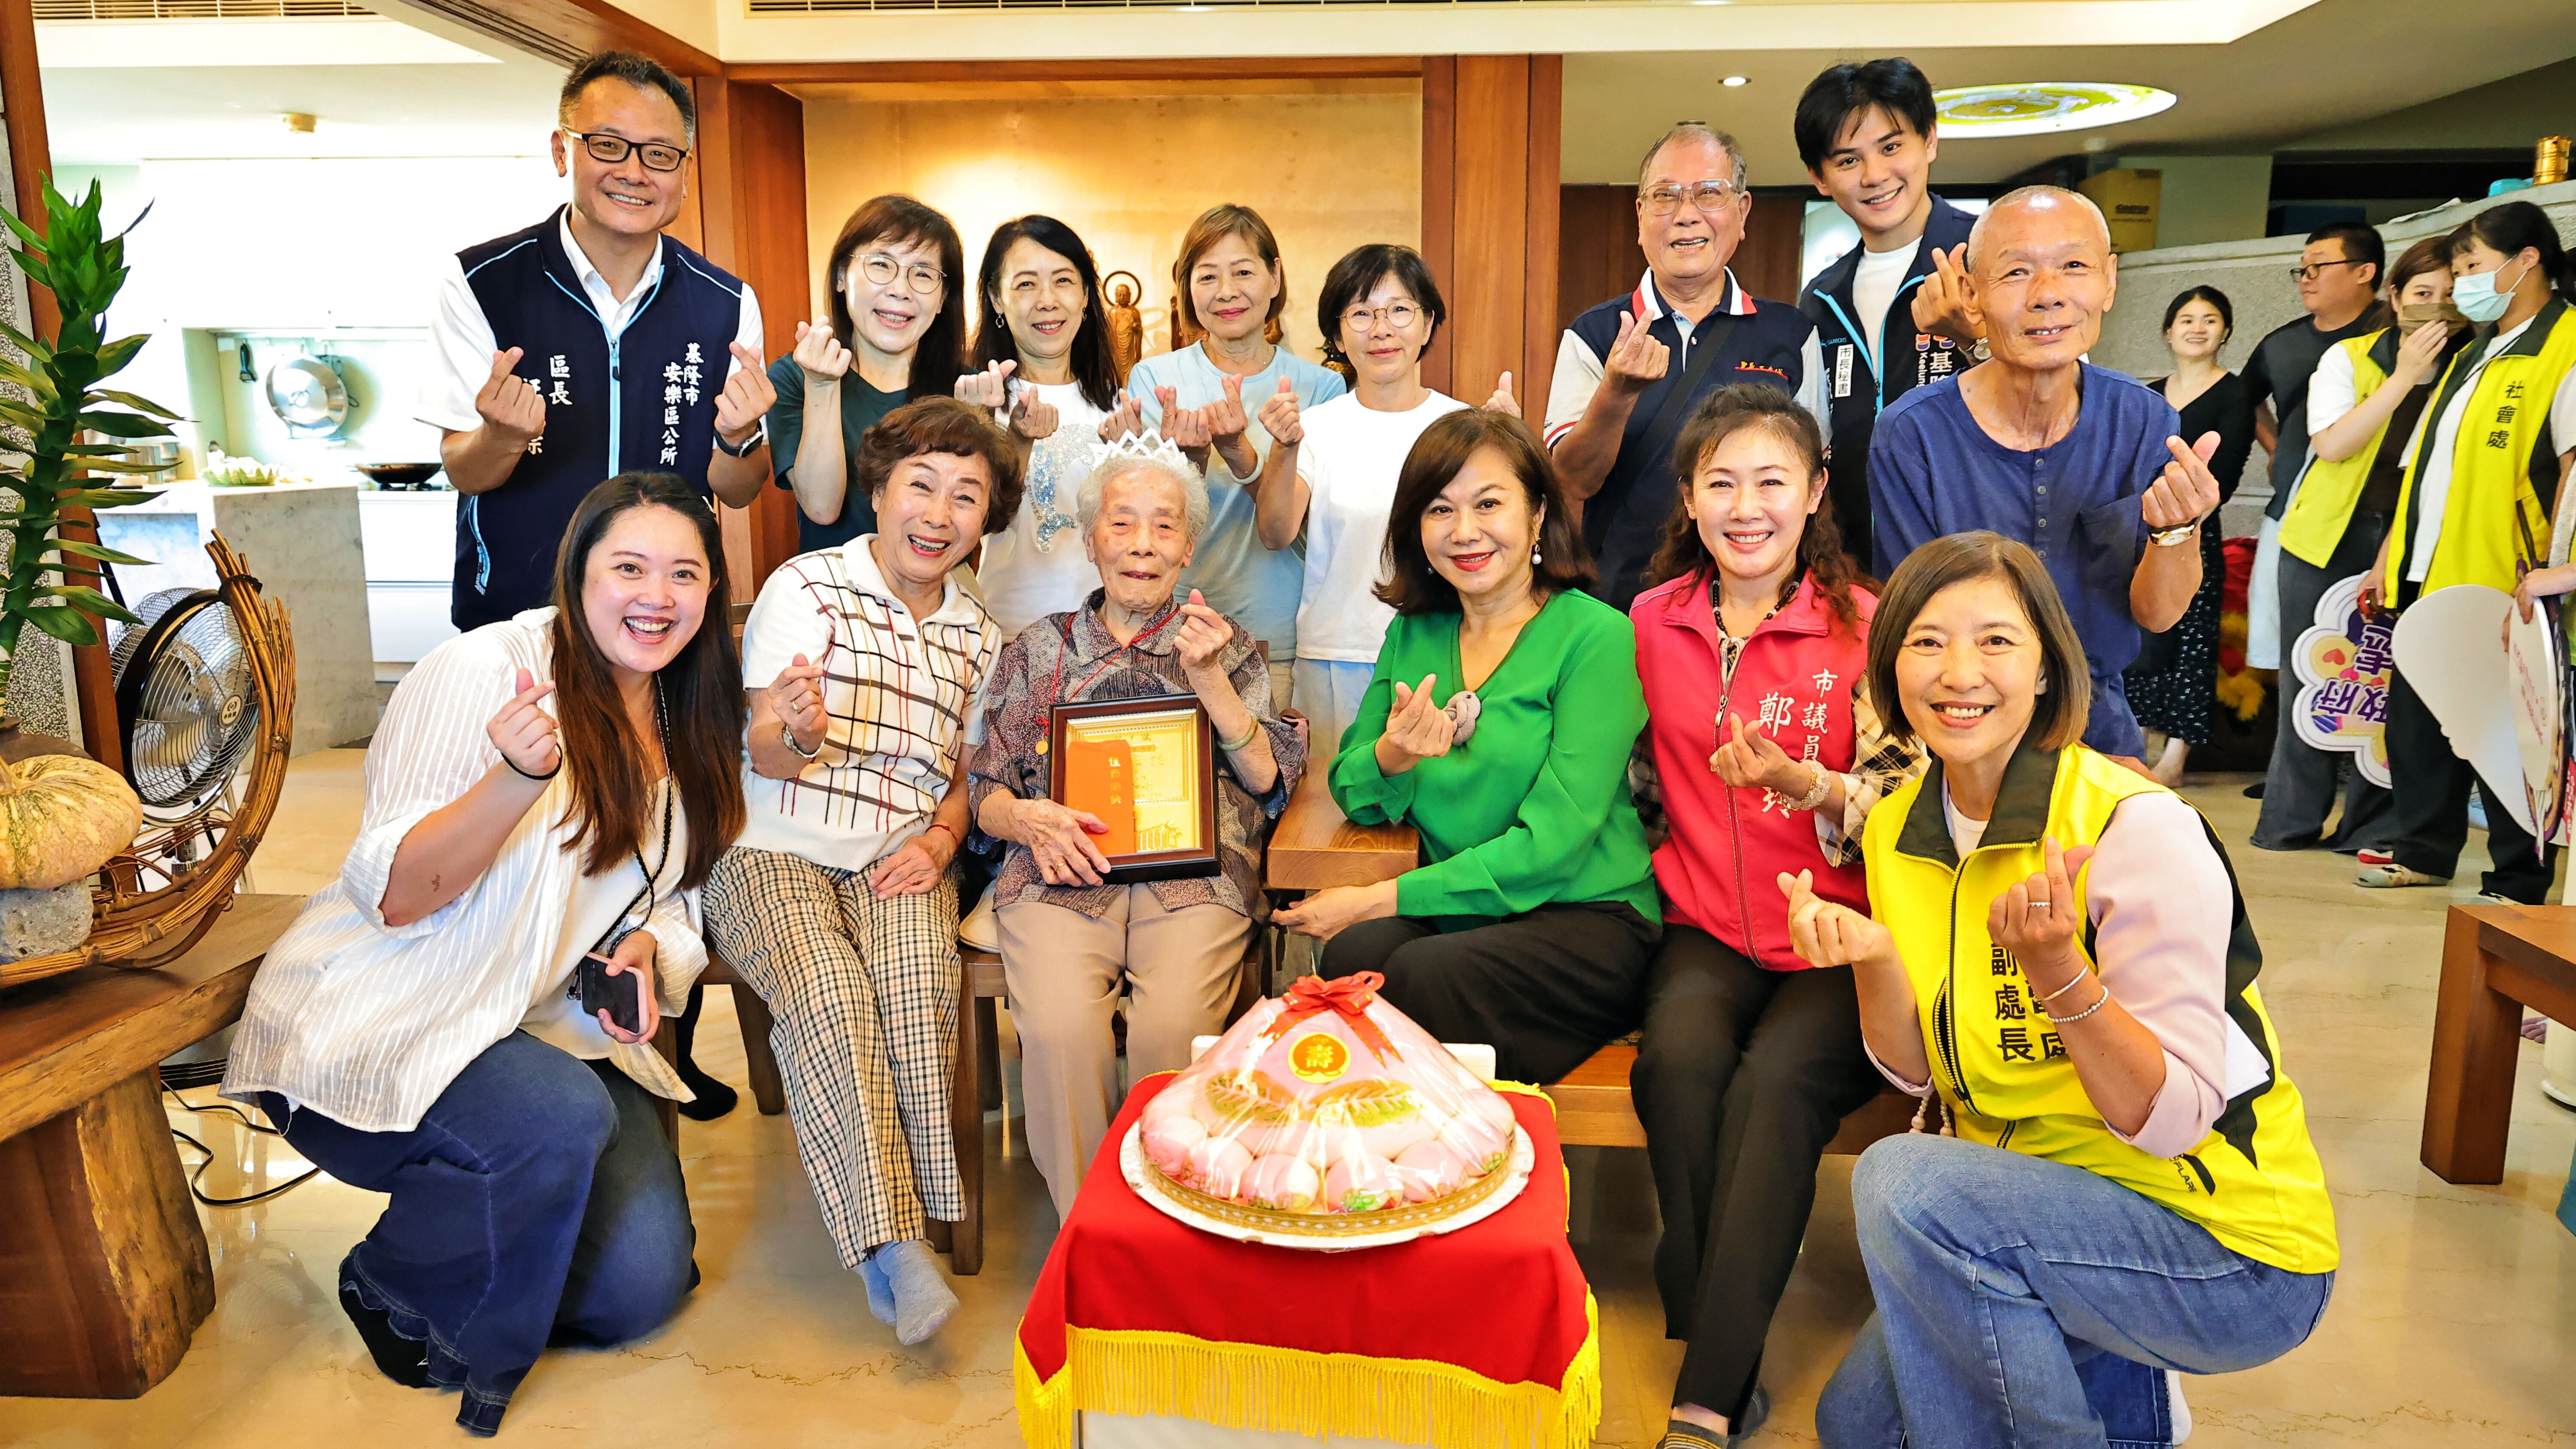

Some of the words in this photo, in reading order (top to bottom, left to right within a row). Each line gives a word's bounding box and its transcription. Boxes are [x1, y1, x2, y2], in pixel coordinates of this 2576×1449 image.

[548, 355, 573, 405] 區長
[683, 342, 705, 407] 基隆市
[1838, 347, 1852, 395] 市長秘書
[1915, 352, 1928, 388] Keelun
[659, 361, 684, 466] 安樂區公所
[2486, 380, 2524, 449] 社會處
[1800, 668, 1838, 762] 市議員
[1991, 943, 2036, 1062] 副處長
[1305, 1045, 1334, 1069] 壽
